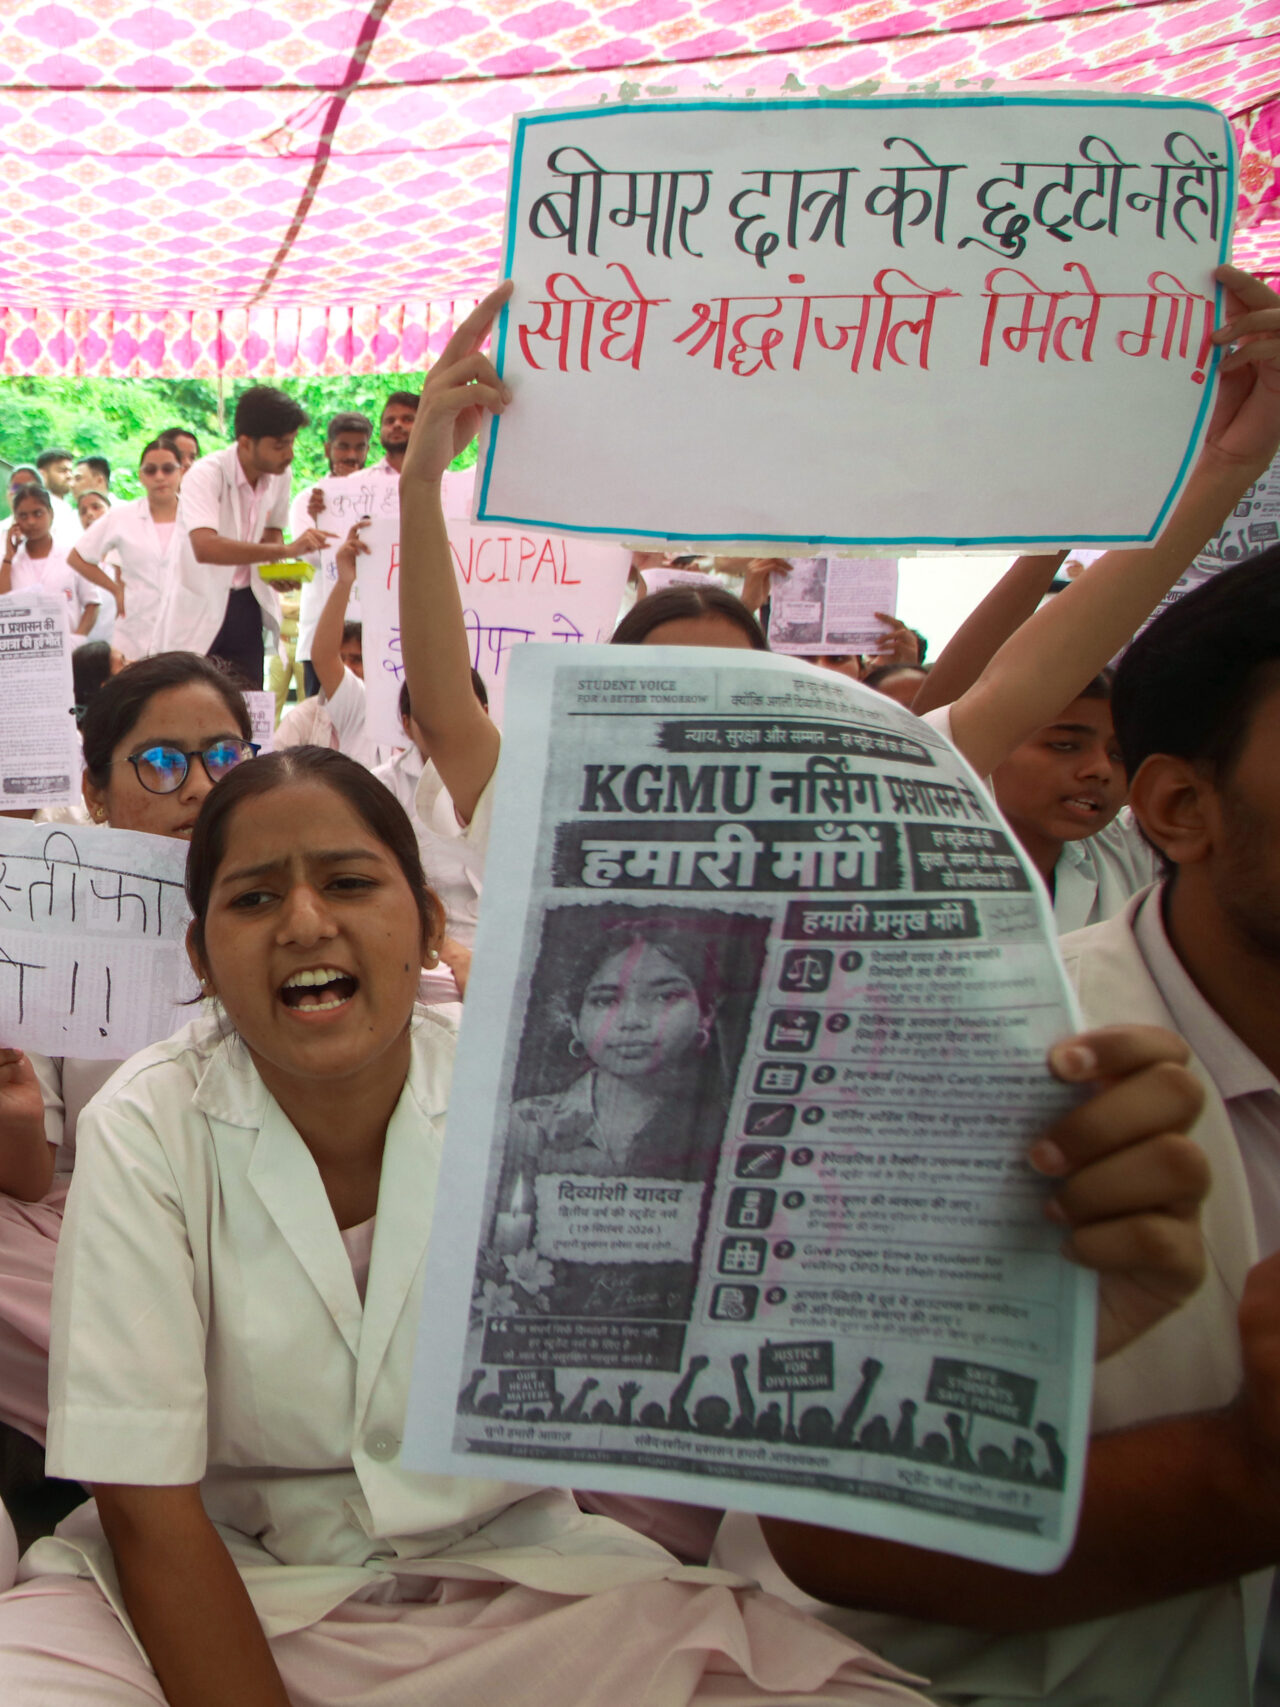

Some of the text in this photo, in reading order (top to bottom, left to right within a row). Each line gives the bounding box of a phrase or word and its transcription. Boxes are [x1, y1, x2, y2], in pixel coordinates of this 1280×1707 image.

[529, 146, 712, 258] बीमार
[865, 137, 966, 248] को
[1126, 132, 1227, 246] नहीं
[519, 263, 670, 372] सीधे
[673, 268, 961, 377] श्रद्धांजलि
[8, 620, 42, 635] प्रशासन
[43, 618, 55, 632] की
[577, 680, 677, 691] STUDENT VOICE
[577, 695, 599, 703] FOR
[610, 695, 648, 703] BETTER
[650, 695, 708, 703] TOMORROW
[685, 728, 722, 744] न्याय,
[725, 728, 760, 749] सुरक्षा
[764, 725, 787, 744] और
[790, 729, 825, 745] सम्मान
[578, 755, 987, 822] KGMU नर्सिंग प्रशासन से
[581, 822, 883, 889] हमारी माँगें
[802, 904, 868, 934] हमारी
[874, 909, 927, 939] प्रमुख
[931, 903, 966, 931] माँगें
[558, 1180, 683, 1203] दिव्यांशी यादव
[771, 1348, 820, 1361] JUSTICE
[784, 1362, 808, 1373] FOR
[508, 1381, 545, 1390] HEALTH
[766, 1374, 828, 1388] DIVYANSHI
[506, 1390, 550, 1400] MATTERS
